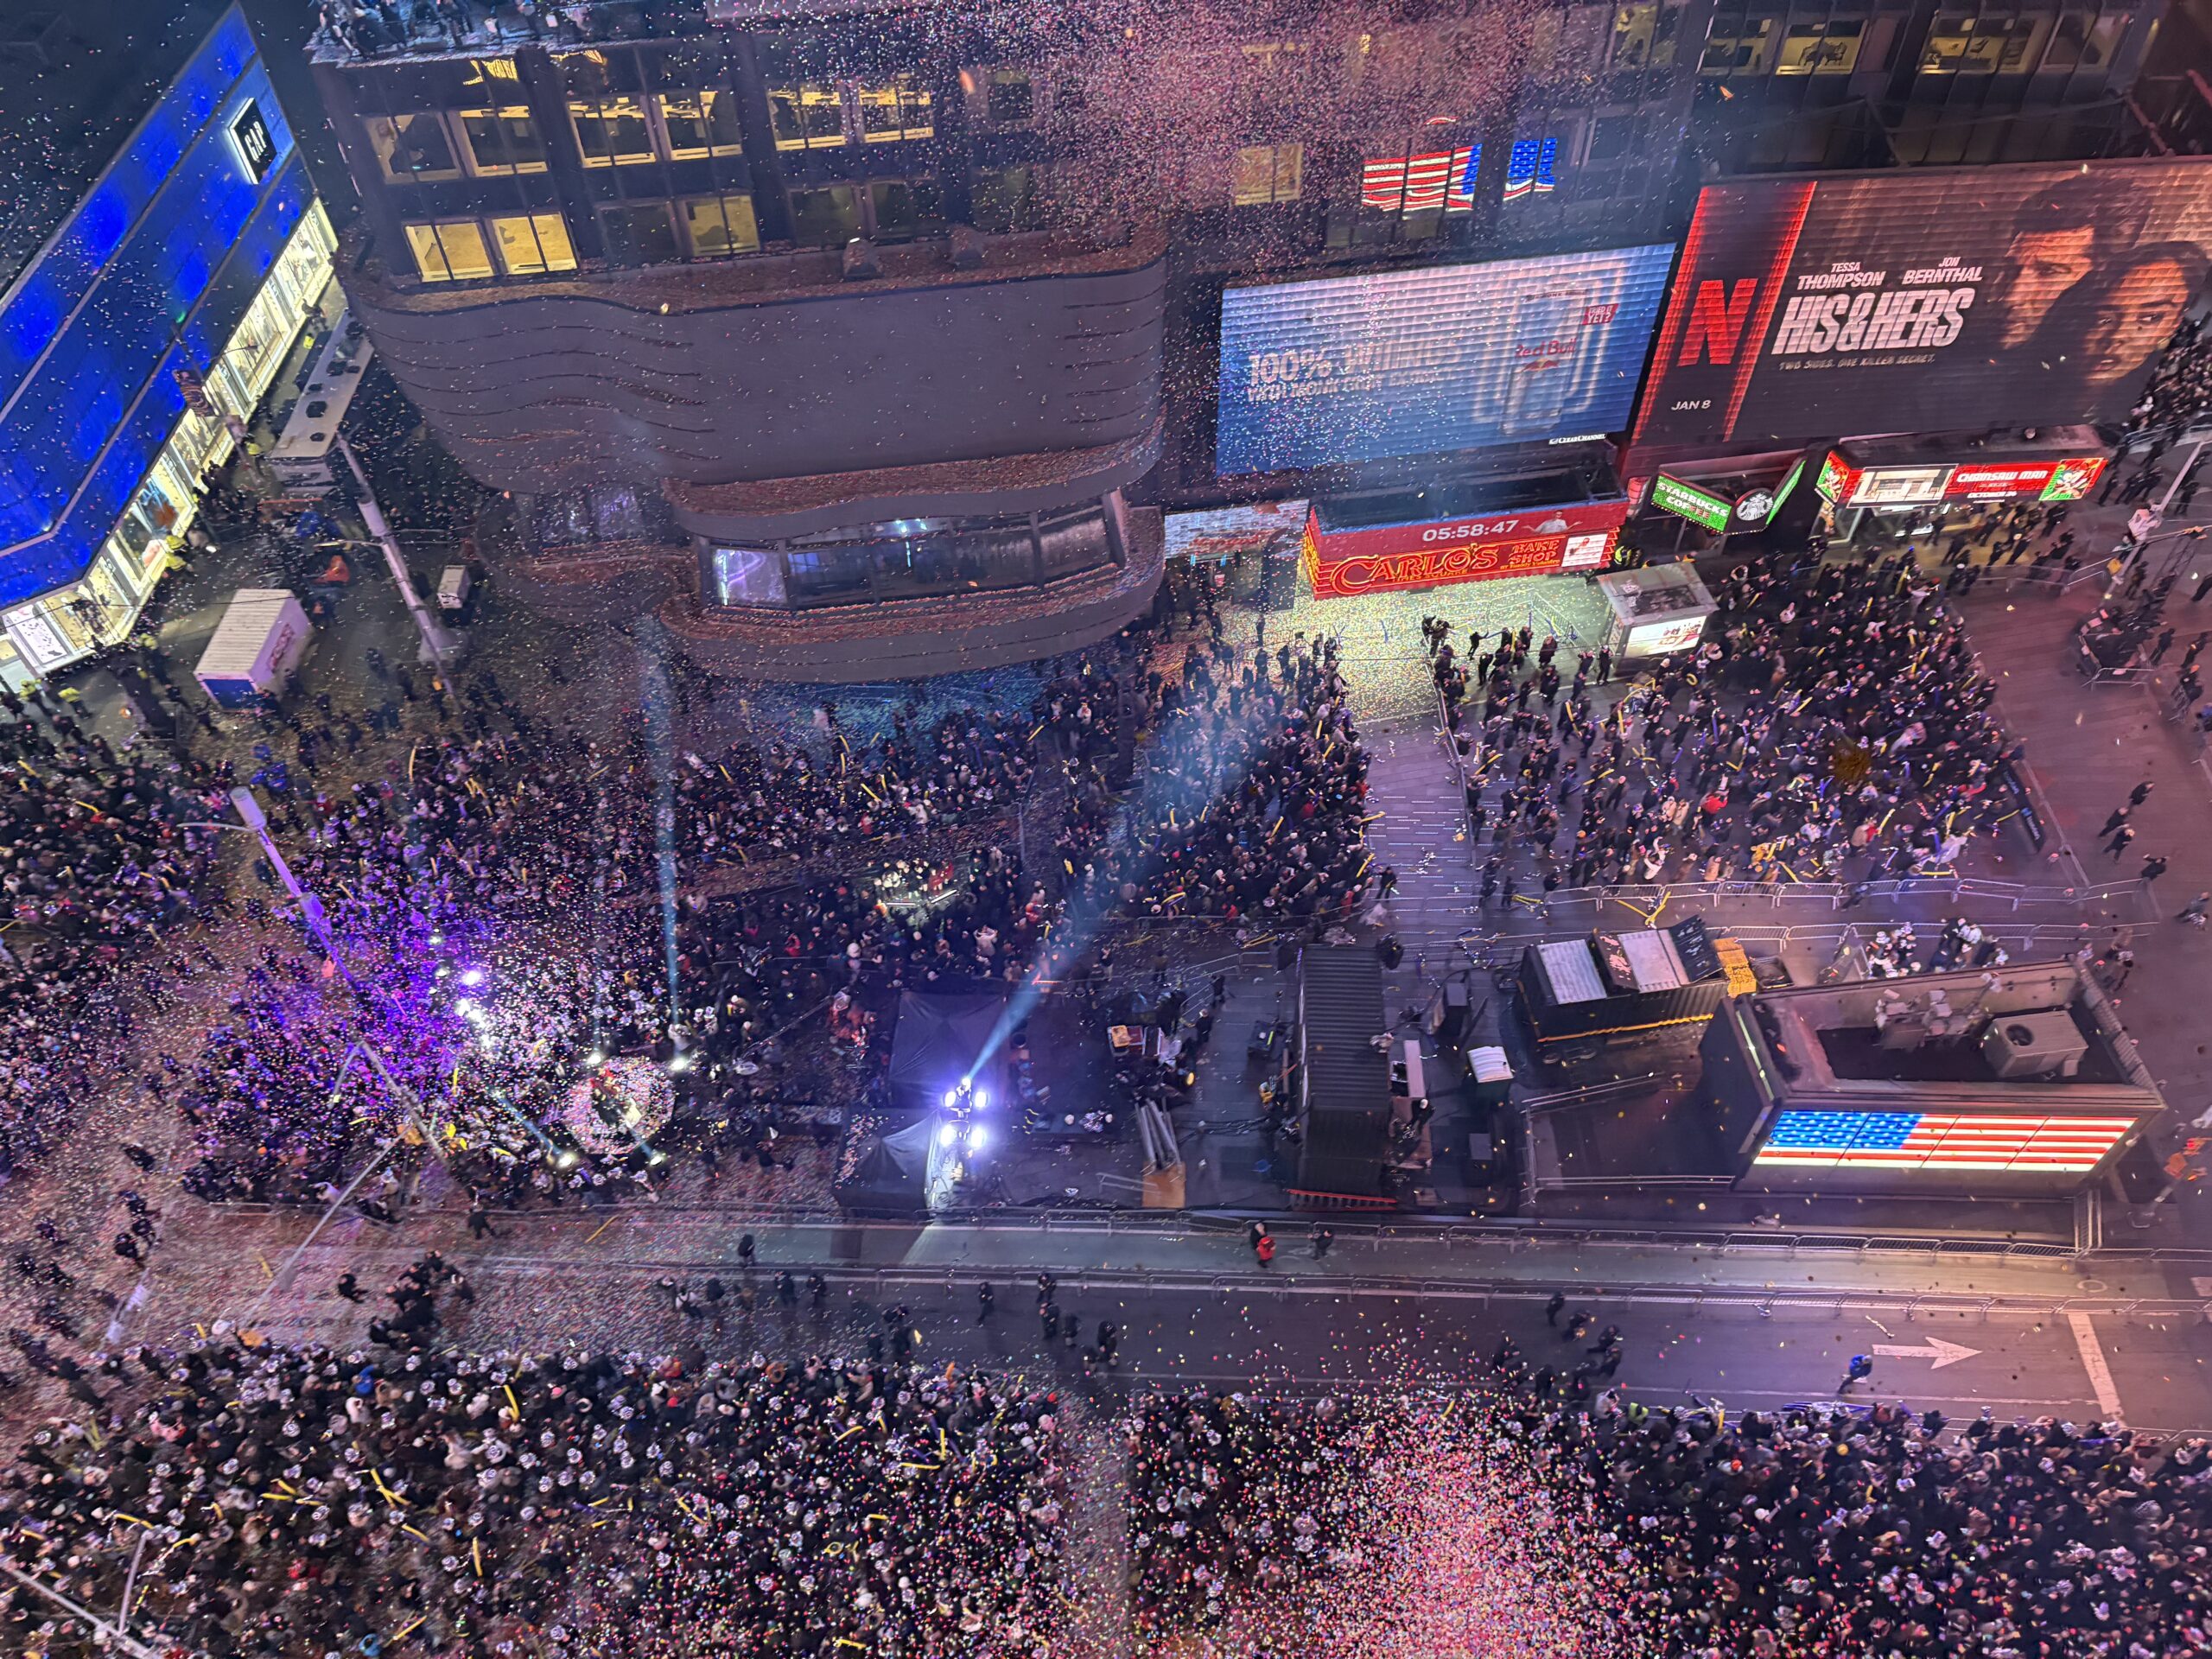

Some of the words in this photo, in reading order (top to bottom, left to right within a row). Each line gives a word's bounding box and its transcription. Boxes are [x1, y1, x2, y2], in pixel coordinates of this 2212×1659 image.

[245, 122, 266, 162] GAP
[1831, 262, 1861, 273] TESSA
[1938, 257, 1961, 268] JON
[1797, 271, 1886, 290] THOMPSON
[1902, 267, 1984, 285] BERNTHAL
[1588, 313, 1611, 324] YET?
[1677, 278, 1758, 366] N
[1771, 288, 1976, 355] HIS&HERS
[1516, 340, 1544, 357] Red
[1547, 338, 1577, 355] Bull
[1249, 347, 1332, 386] 100%
[1671, 400, 1700, 410] JAN
[1701, 399, 1712, 410] 8
[1956, 472, 2018, 483] CHAINSAW
[2018, 470, 2049, 480] MAN
[1657, 482, 1728, 517] STARBUCKS
[1666, 496, 1710, 519] COFFEE
[1422, 519, 1519, 542] 05:58:47
[1512, 540, 1560, 554] BAKE
[1508, 551, 1556, 564] SHOP
[1331, 543, 1499, 594] CARLO'S
[1425, 569, 1468, 580] SQUARE
